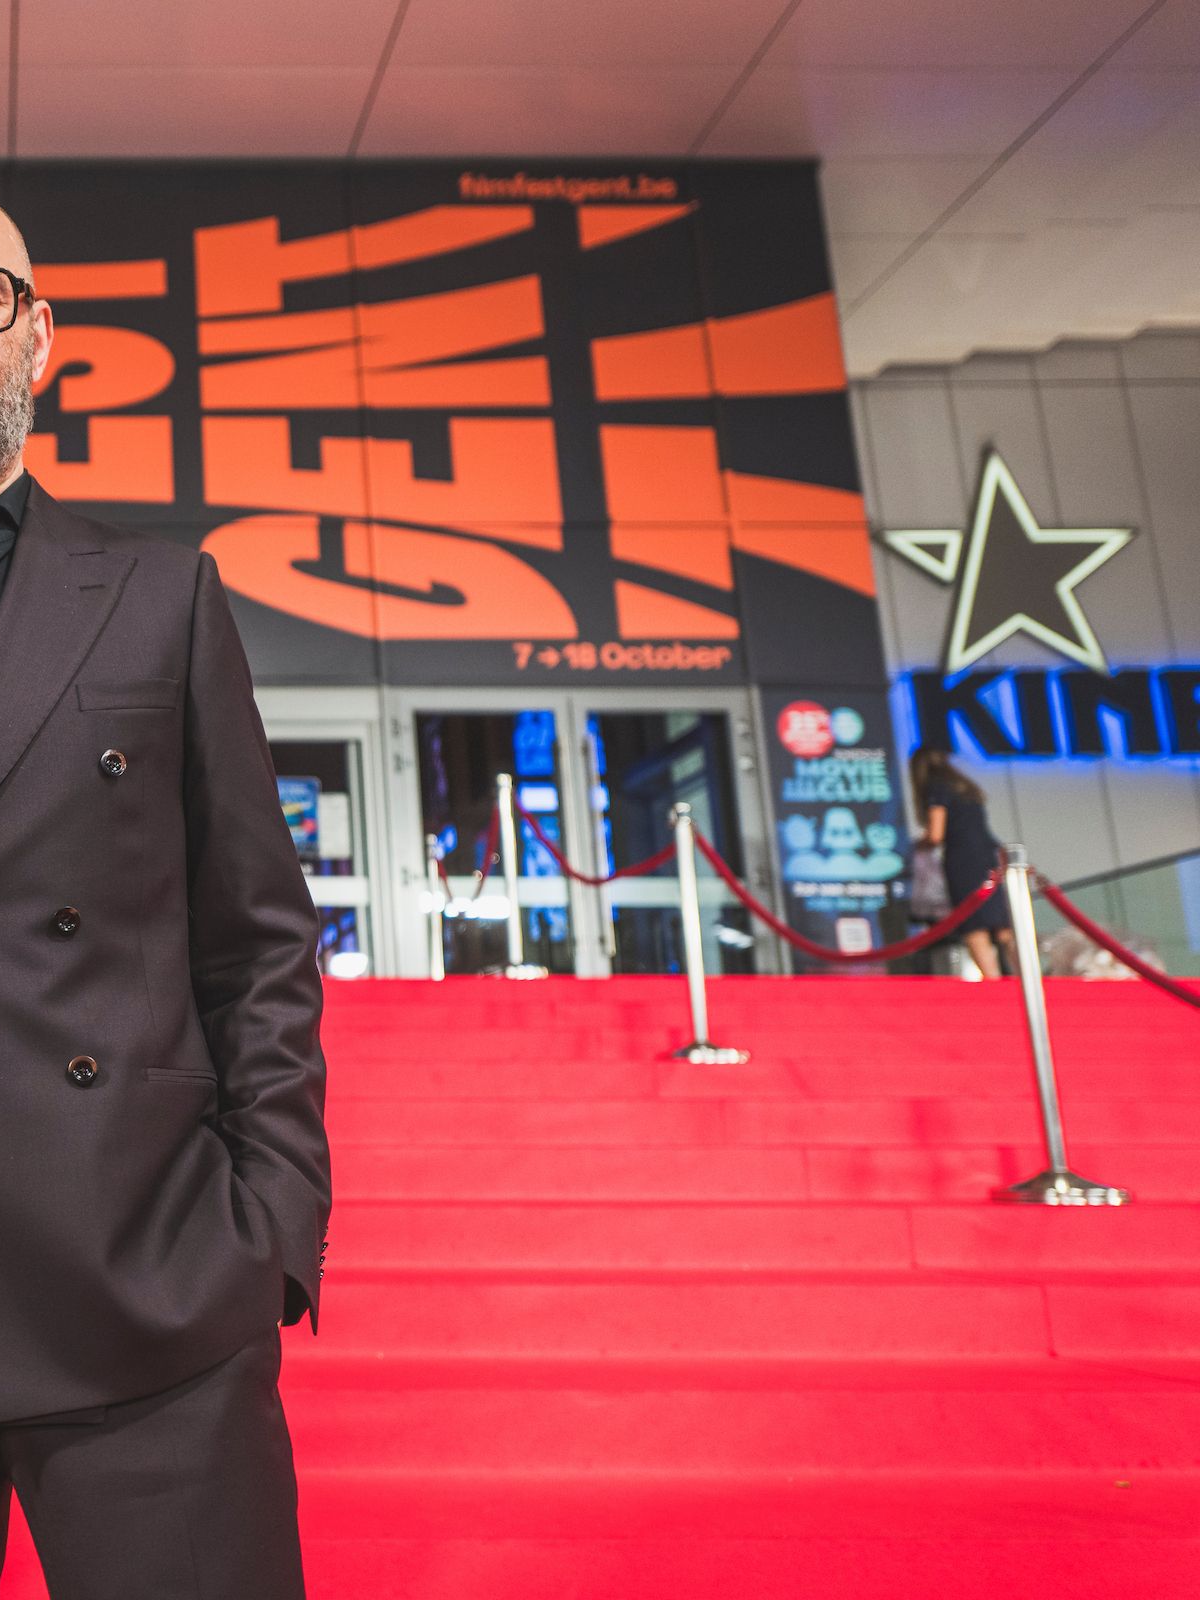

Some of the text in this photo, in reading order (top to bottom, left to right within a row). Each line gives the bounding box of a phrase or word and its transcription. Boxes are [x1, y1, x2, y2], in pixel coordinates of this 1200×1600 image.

[459, 172, 678, 203] filmfestgent.be
[194, 206, 579, 640] GENT
[512, 642, 533, 671] 7
[600, 641, 732, 671] October
